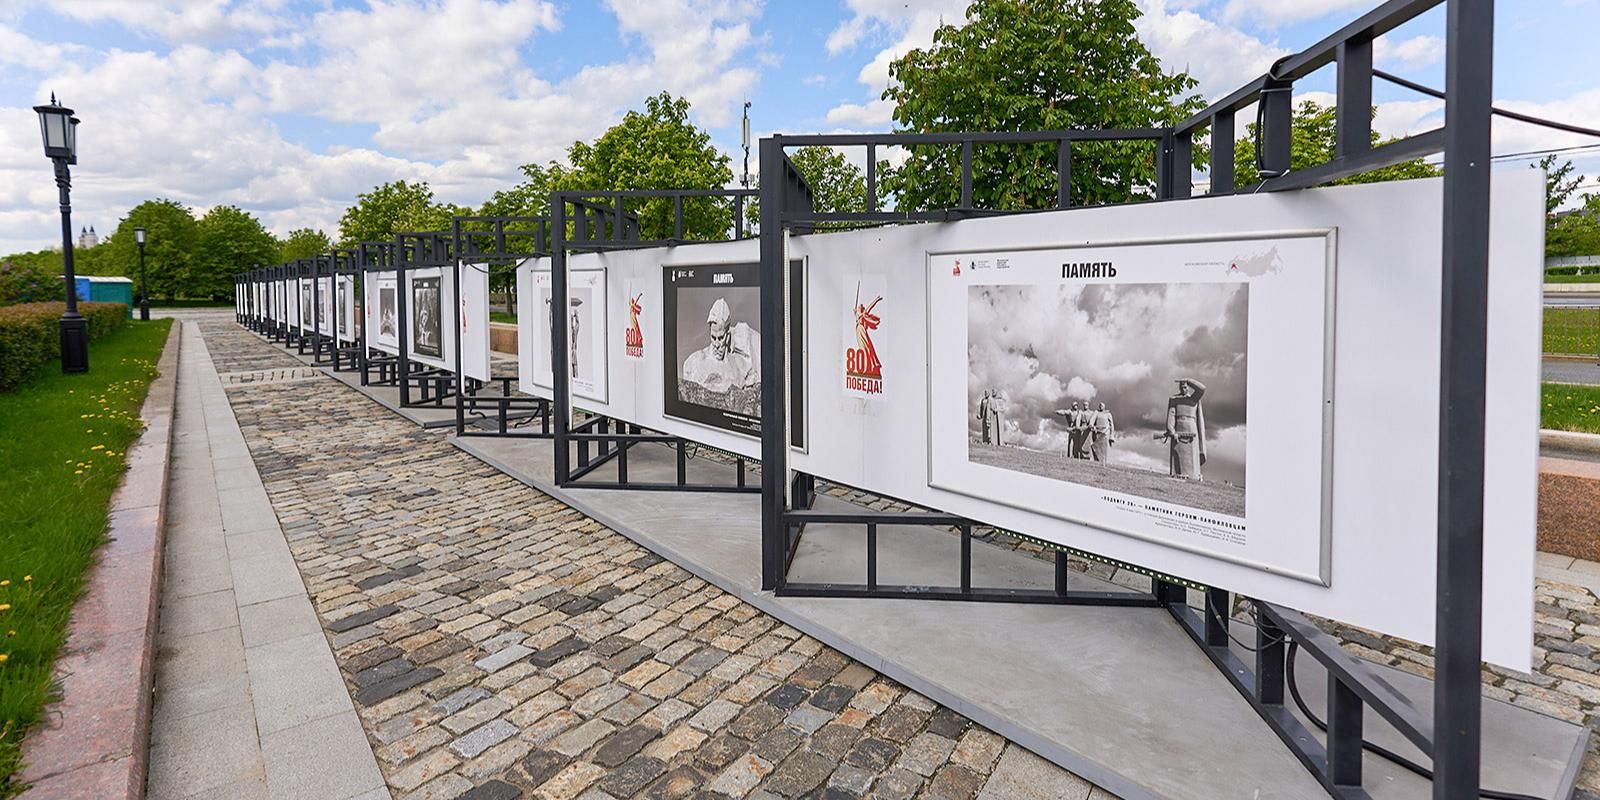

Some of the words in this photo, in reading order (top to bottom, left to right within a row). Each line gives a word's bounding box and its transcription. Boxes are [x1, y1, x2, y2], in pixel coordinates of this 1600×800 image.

[1062, 262, 1117, 279] ПАМЯТЬ
[626, 327, 636, 345] 80
[846, 347, 865, 374] 80
[846, 376, 883, 394] ПОБЕДА!
